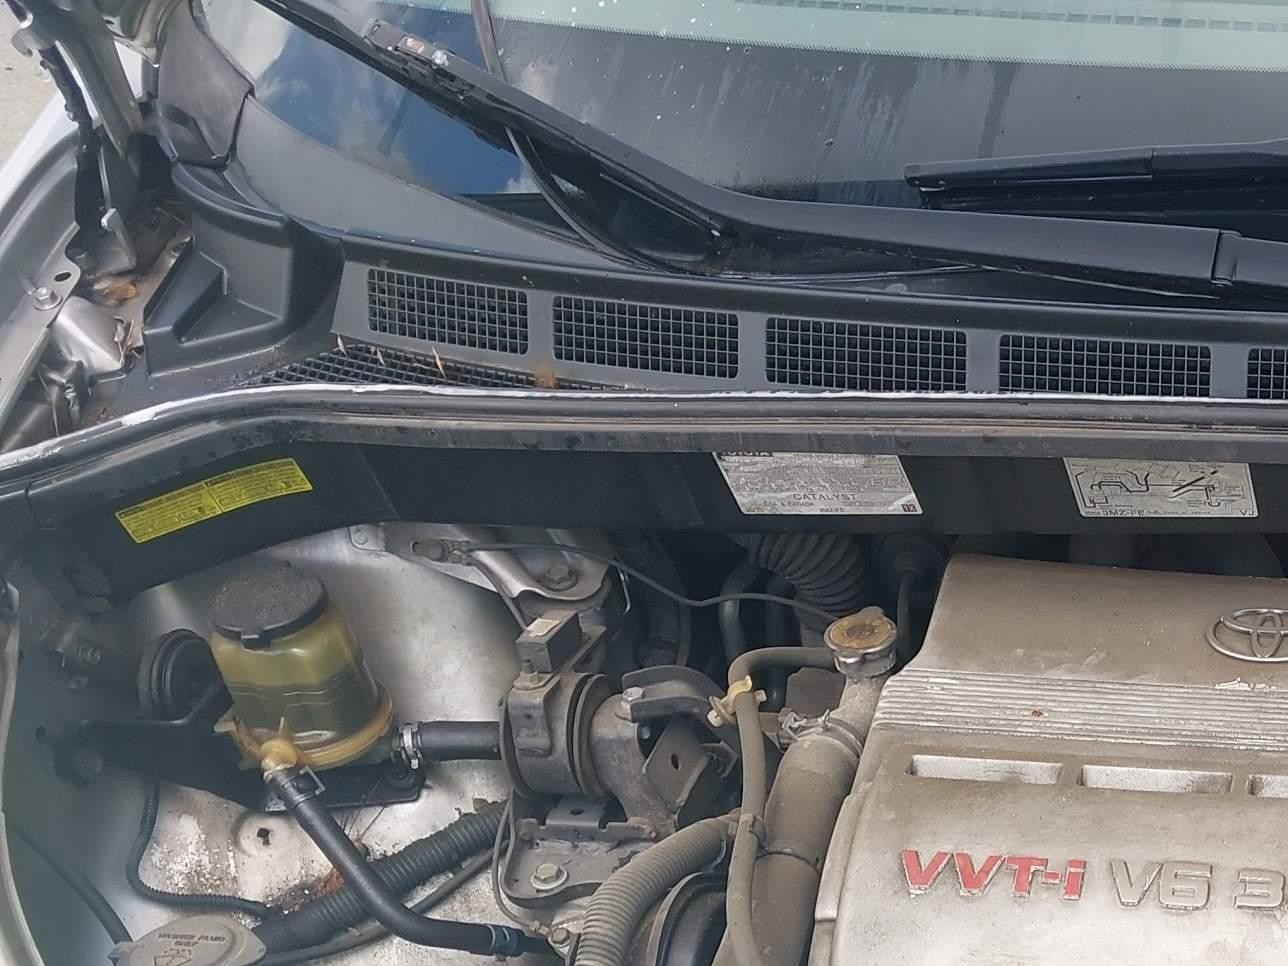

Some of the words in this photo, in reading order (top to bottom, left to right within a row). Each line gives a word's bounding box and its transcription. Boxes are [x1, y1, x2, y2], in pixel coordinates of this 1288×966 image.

[793, 493, 857, 501] CATALYST
[901, 848, 1087, 900] VVT-i
[1109, 858, 1212, 911] V6
